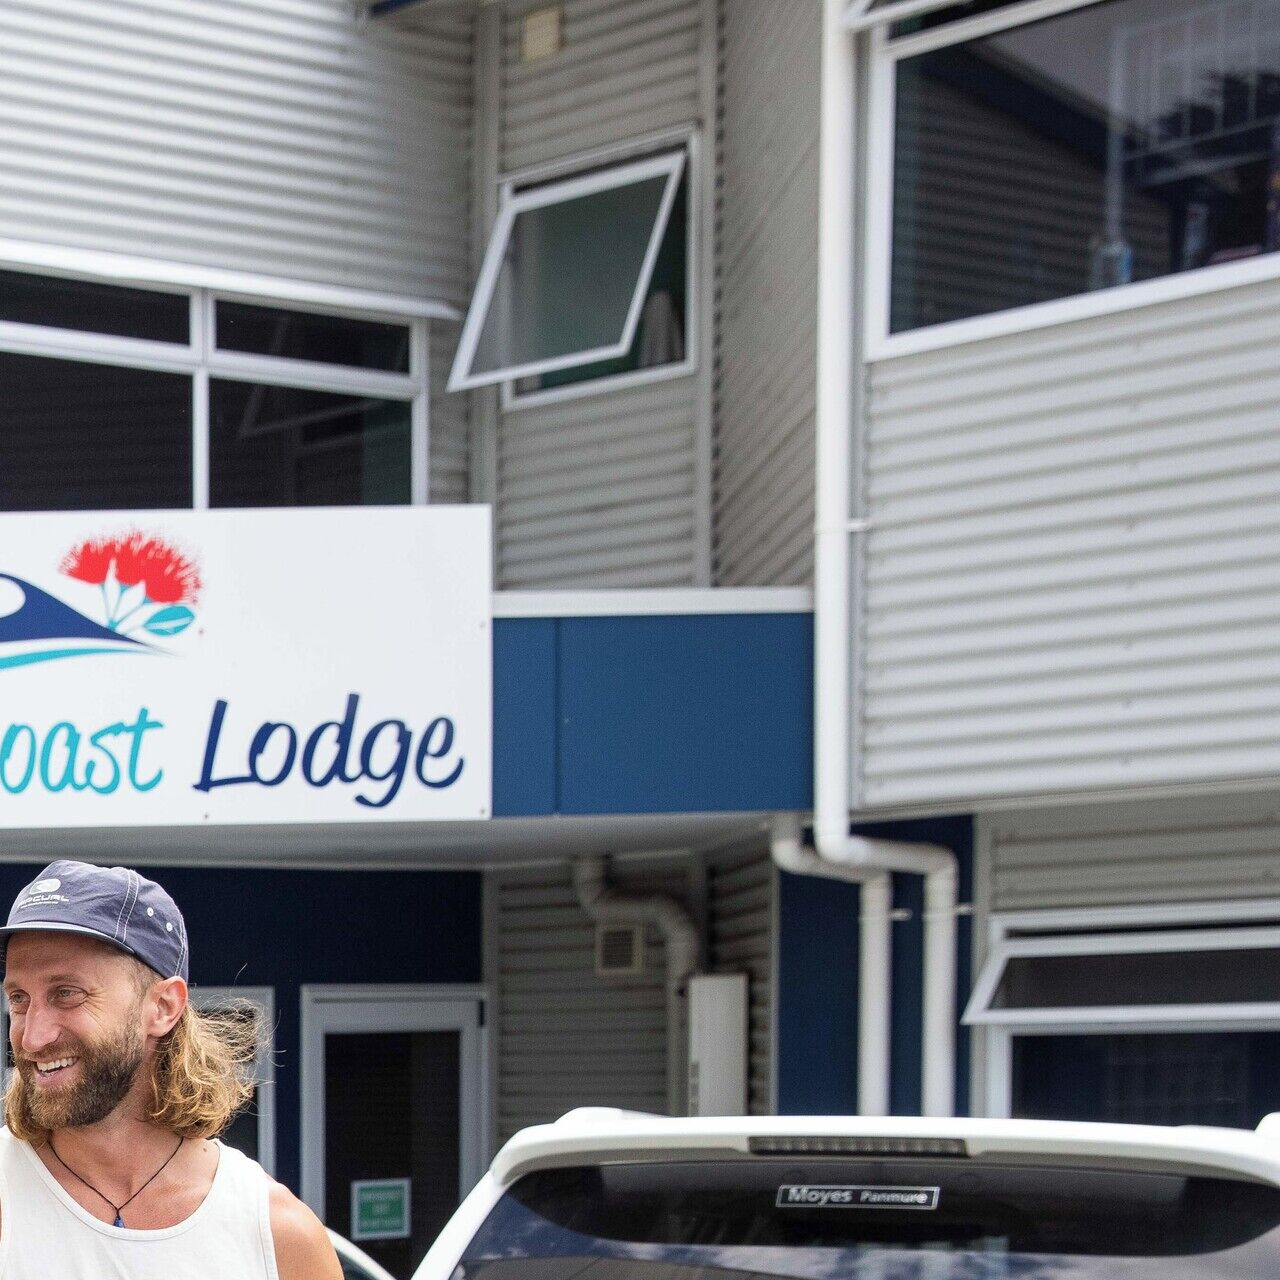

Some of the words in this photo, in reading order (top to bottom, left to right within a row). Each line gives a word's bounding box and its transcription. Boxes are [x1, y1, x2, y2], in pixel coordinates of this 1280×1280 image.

[192, 692, 466, 809] Lodge
[787, 1187, 853, 1206] Moyes
[859, 1190, 929, 1205] Panmure
